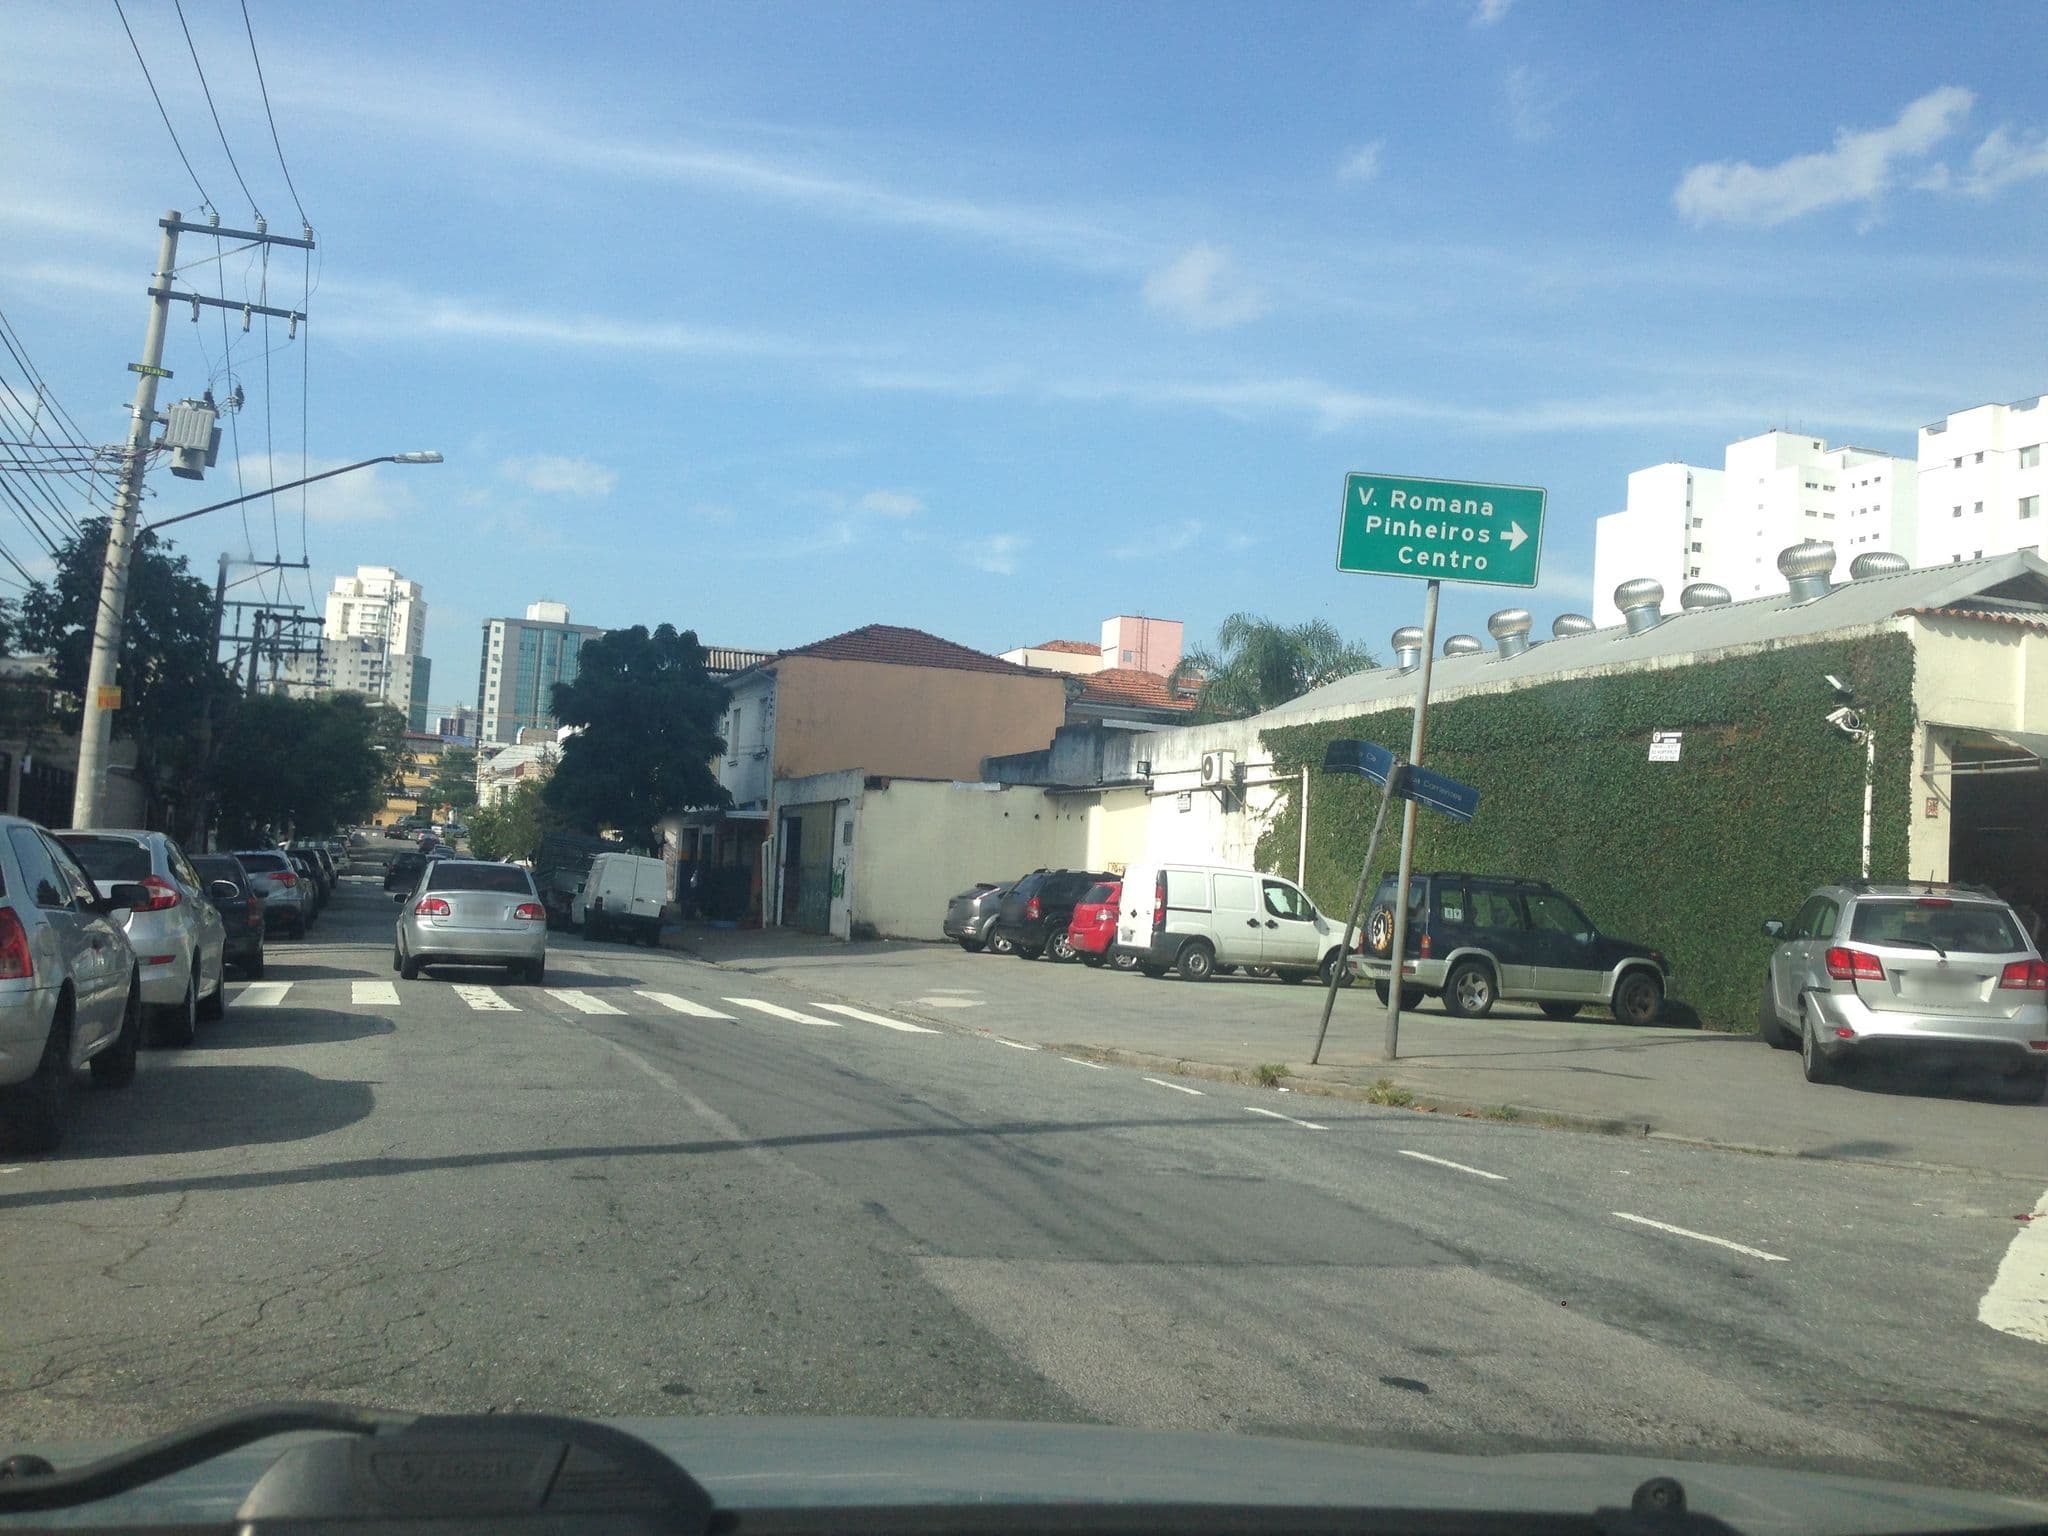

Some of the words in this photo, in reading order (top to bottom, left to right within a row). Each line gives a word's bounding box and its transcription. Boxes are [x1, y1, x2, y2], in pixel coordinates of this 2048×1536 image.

[1358, 486, 1378, 506] V.
[1390, 489, 1494, 516] Romana
[1365, 515, 1491, 544] Pinheiros
[1398, 546, 1489, 570] Centro
